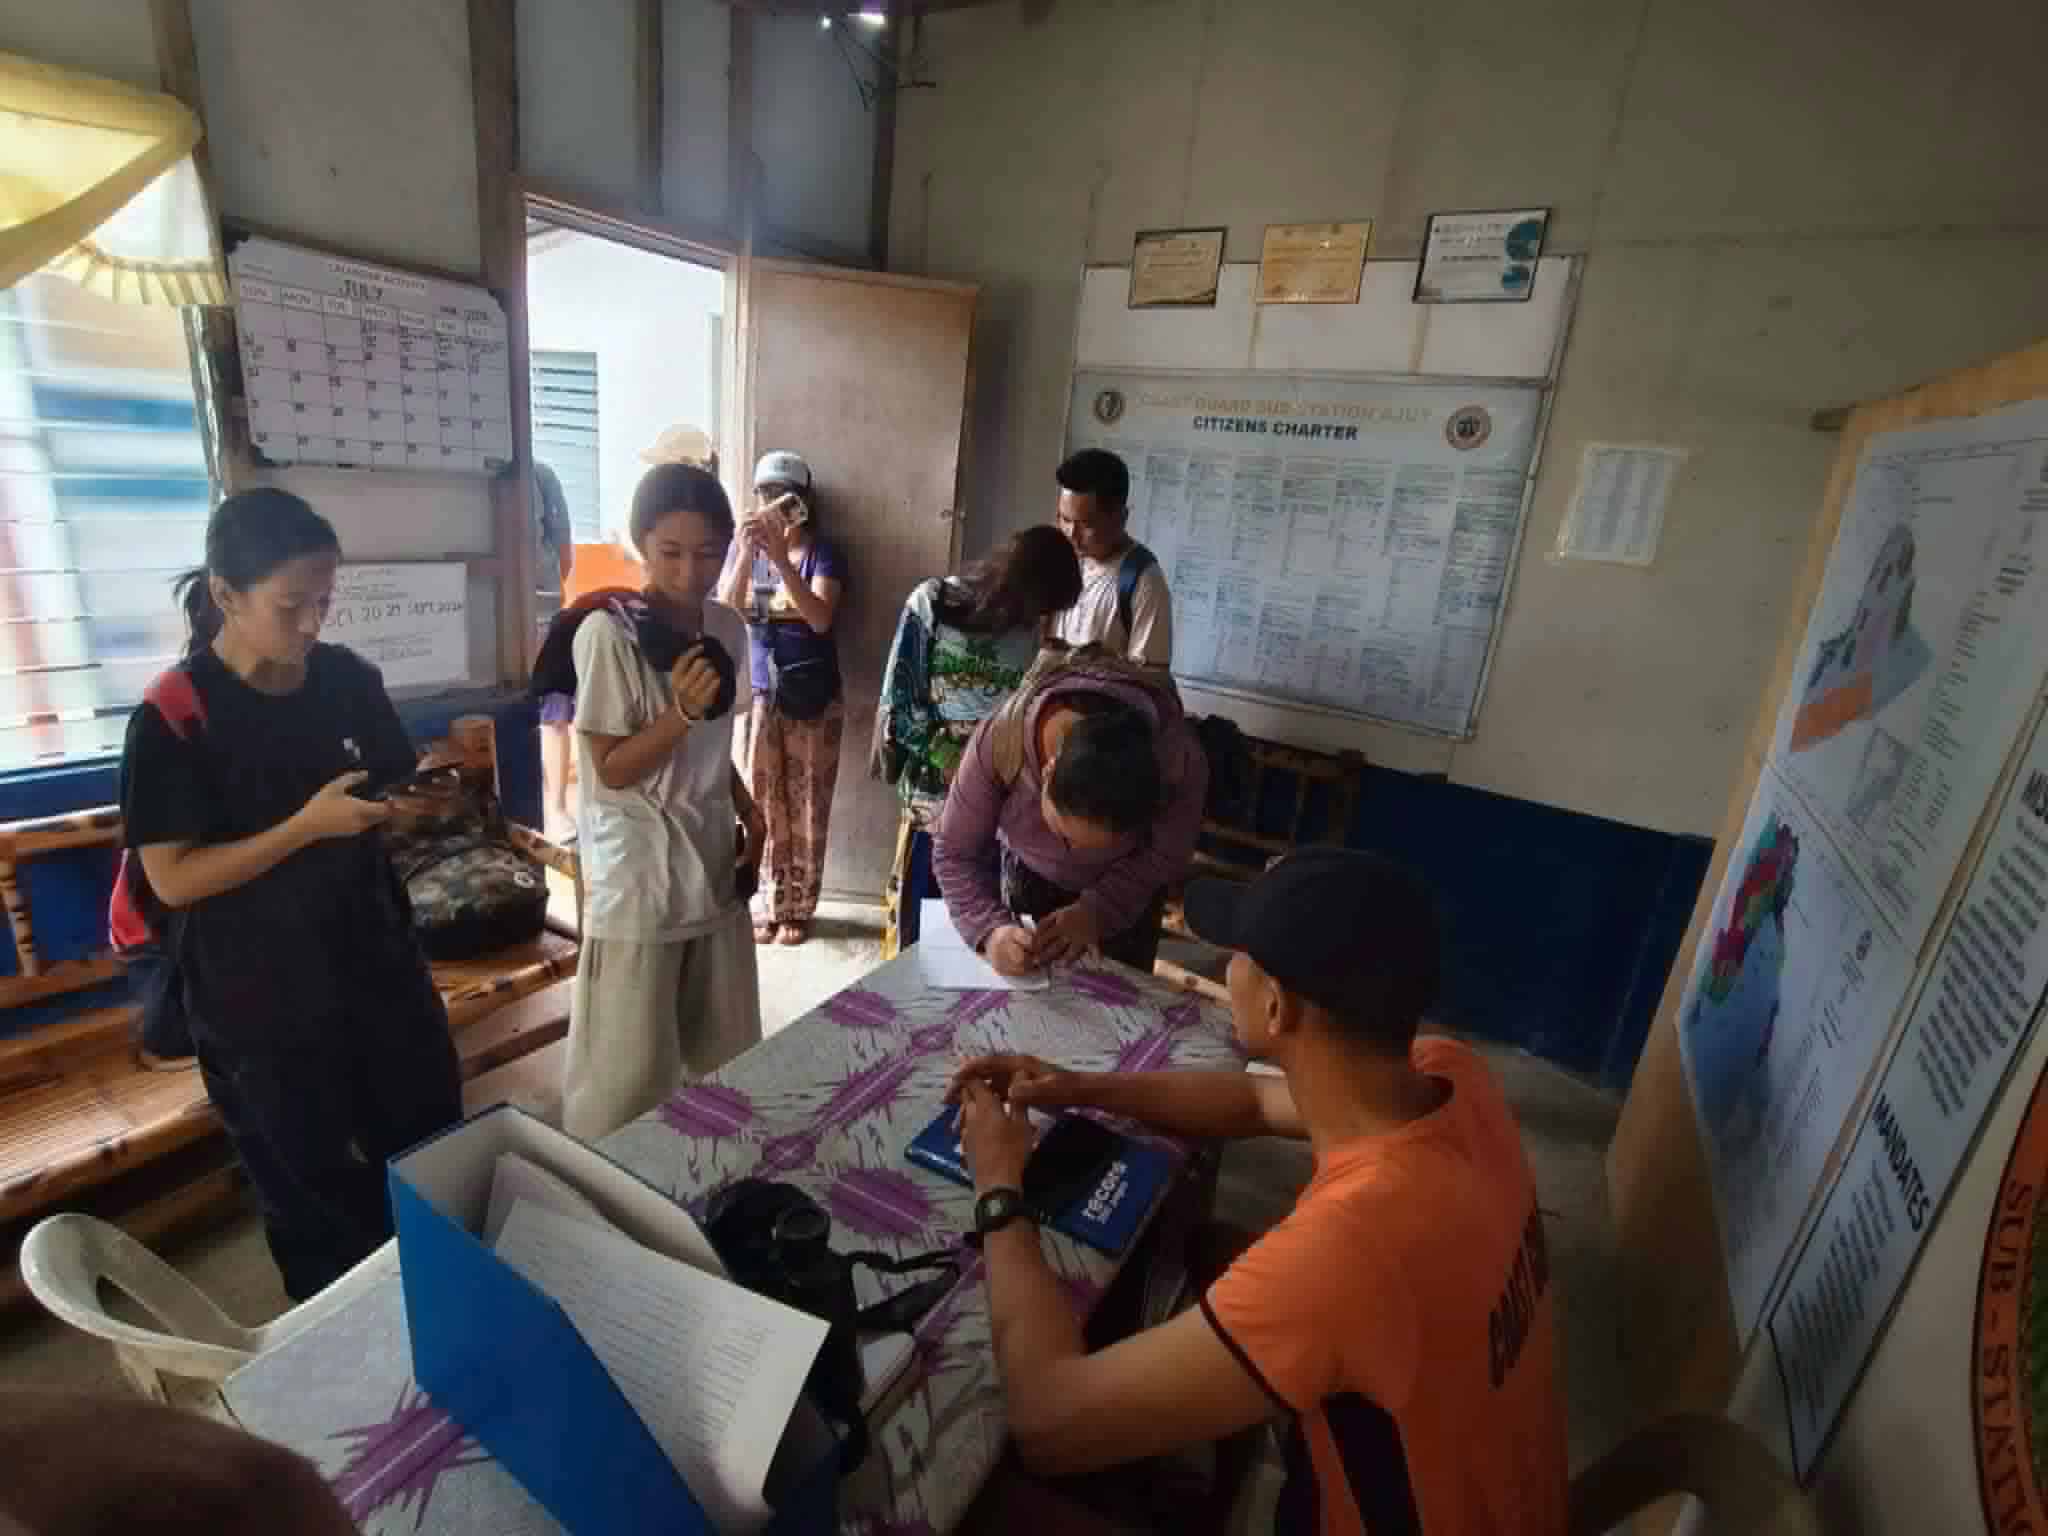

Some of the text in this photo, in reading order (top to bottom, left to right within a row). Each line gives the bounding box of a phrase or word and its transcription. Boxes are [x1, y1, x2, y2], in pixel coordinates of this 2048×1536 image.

[1193, 416, 1359, 441] CITIZENS CHARTER
[1873, 1091, 1930, 1232] MANDATES
